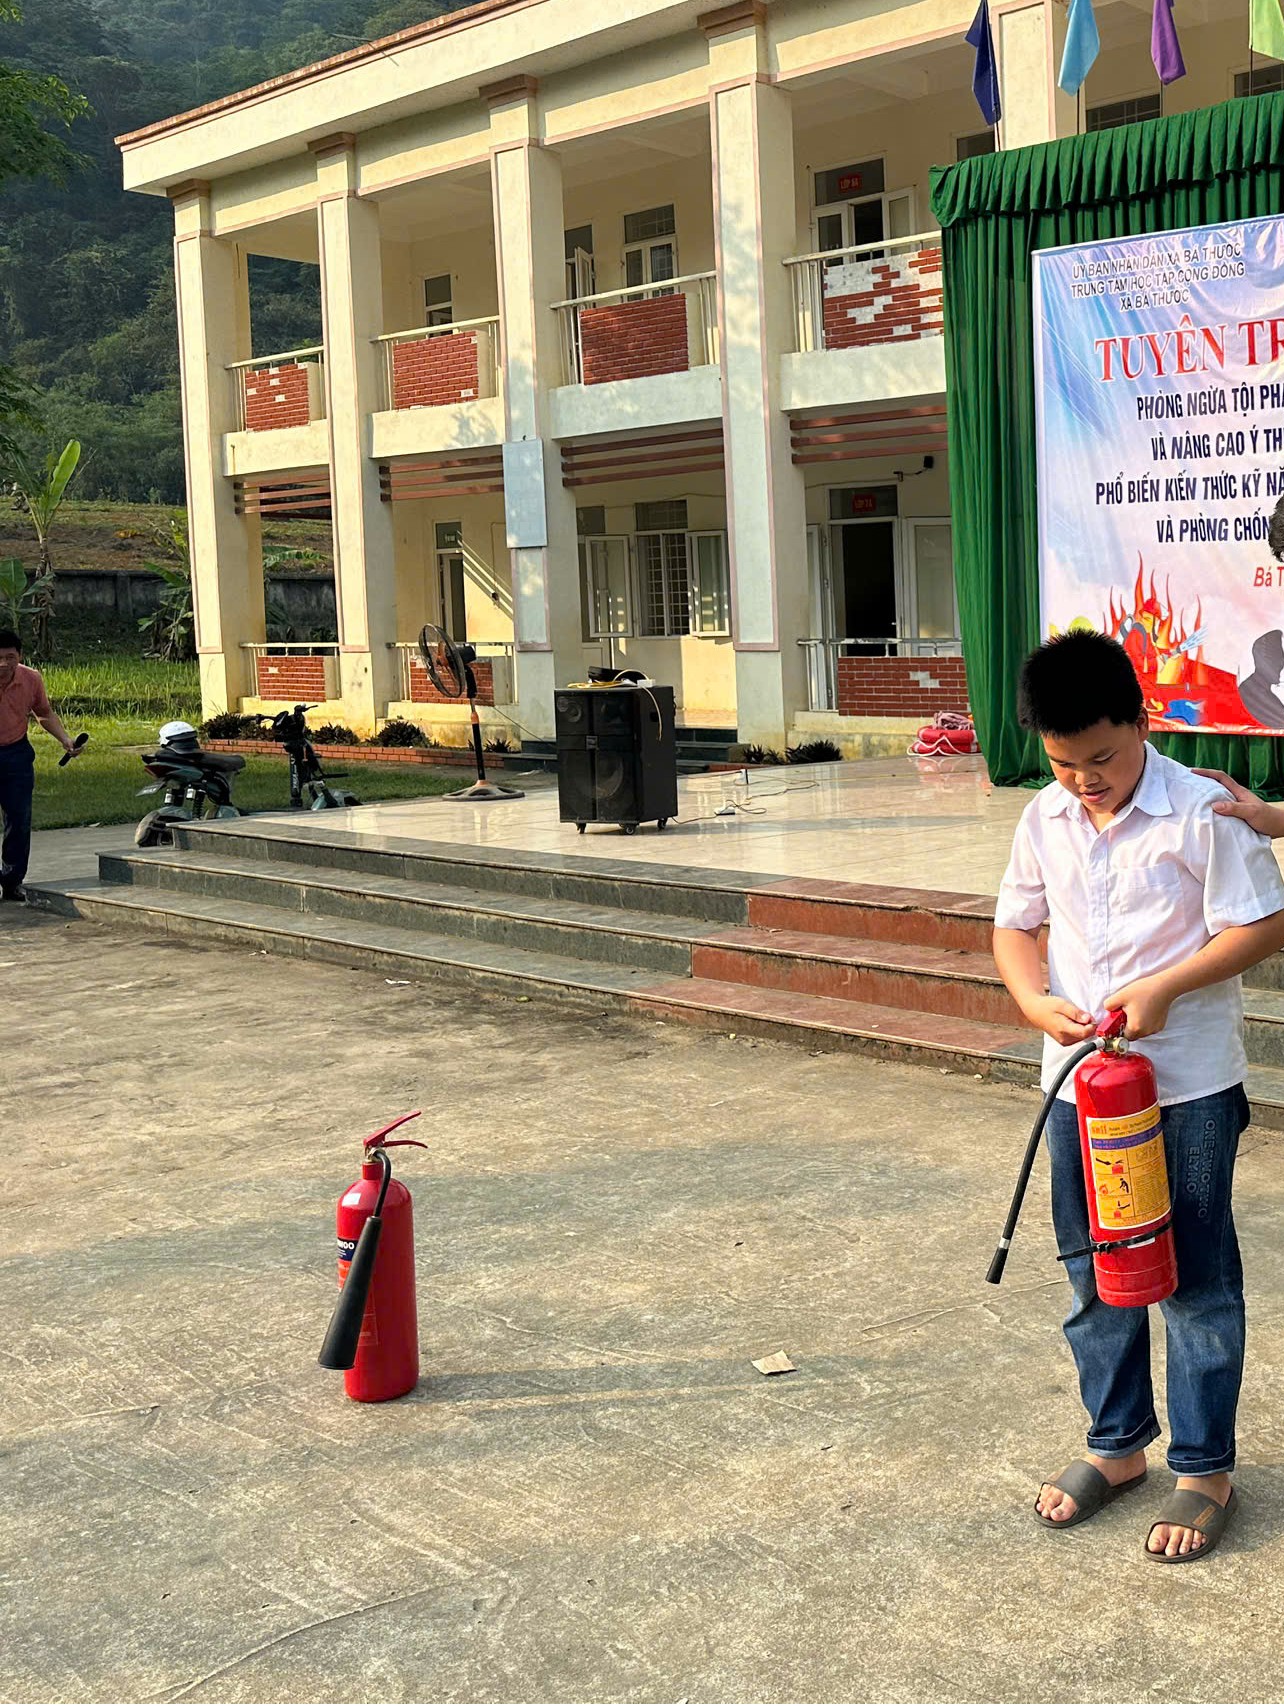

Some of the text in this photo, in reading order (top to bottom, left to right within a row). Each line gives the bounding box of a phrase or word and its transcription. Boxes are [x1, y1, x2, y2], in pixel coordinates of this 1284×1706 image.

[1088, 262, 1109, 277] BAN
[1112, 255, 1140, 274] NHÂN
[1142, 253, 1164, 270] DÂN
[1071, 281, 1105, 298] TRUNG
[1095, 314, 1227, 381] TUYÊN
[1137, 390, 1183, 421] PHÒNG
[1187, 385, 1227, 417] NGỪA
[1232, 381, 1255, 417] TỘI
[1151, 432, 1167, 461] VÀ
[1171, 430, 1211, 460] NÂNG
[1215, 431, 1245, 457] CAO
[1249, 424, 1259, 454] Ý
[1096, 471, 1124, 505] PHỔ
[1127, 472, 1160, 503] BIẾN
[1165, 469, 1197, 501] KIẾN
[1202, 470, 1237, 500] THỨC
[1242, 468, 1261, 498] KỸ
[1156, 514, 1174, 543] VÀ
[1179, 512, 1229, 542] PHÒNG
[1253, 566, 1272, 587] Bá
